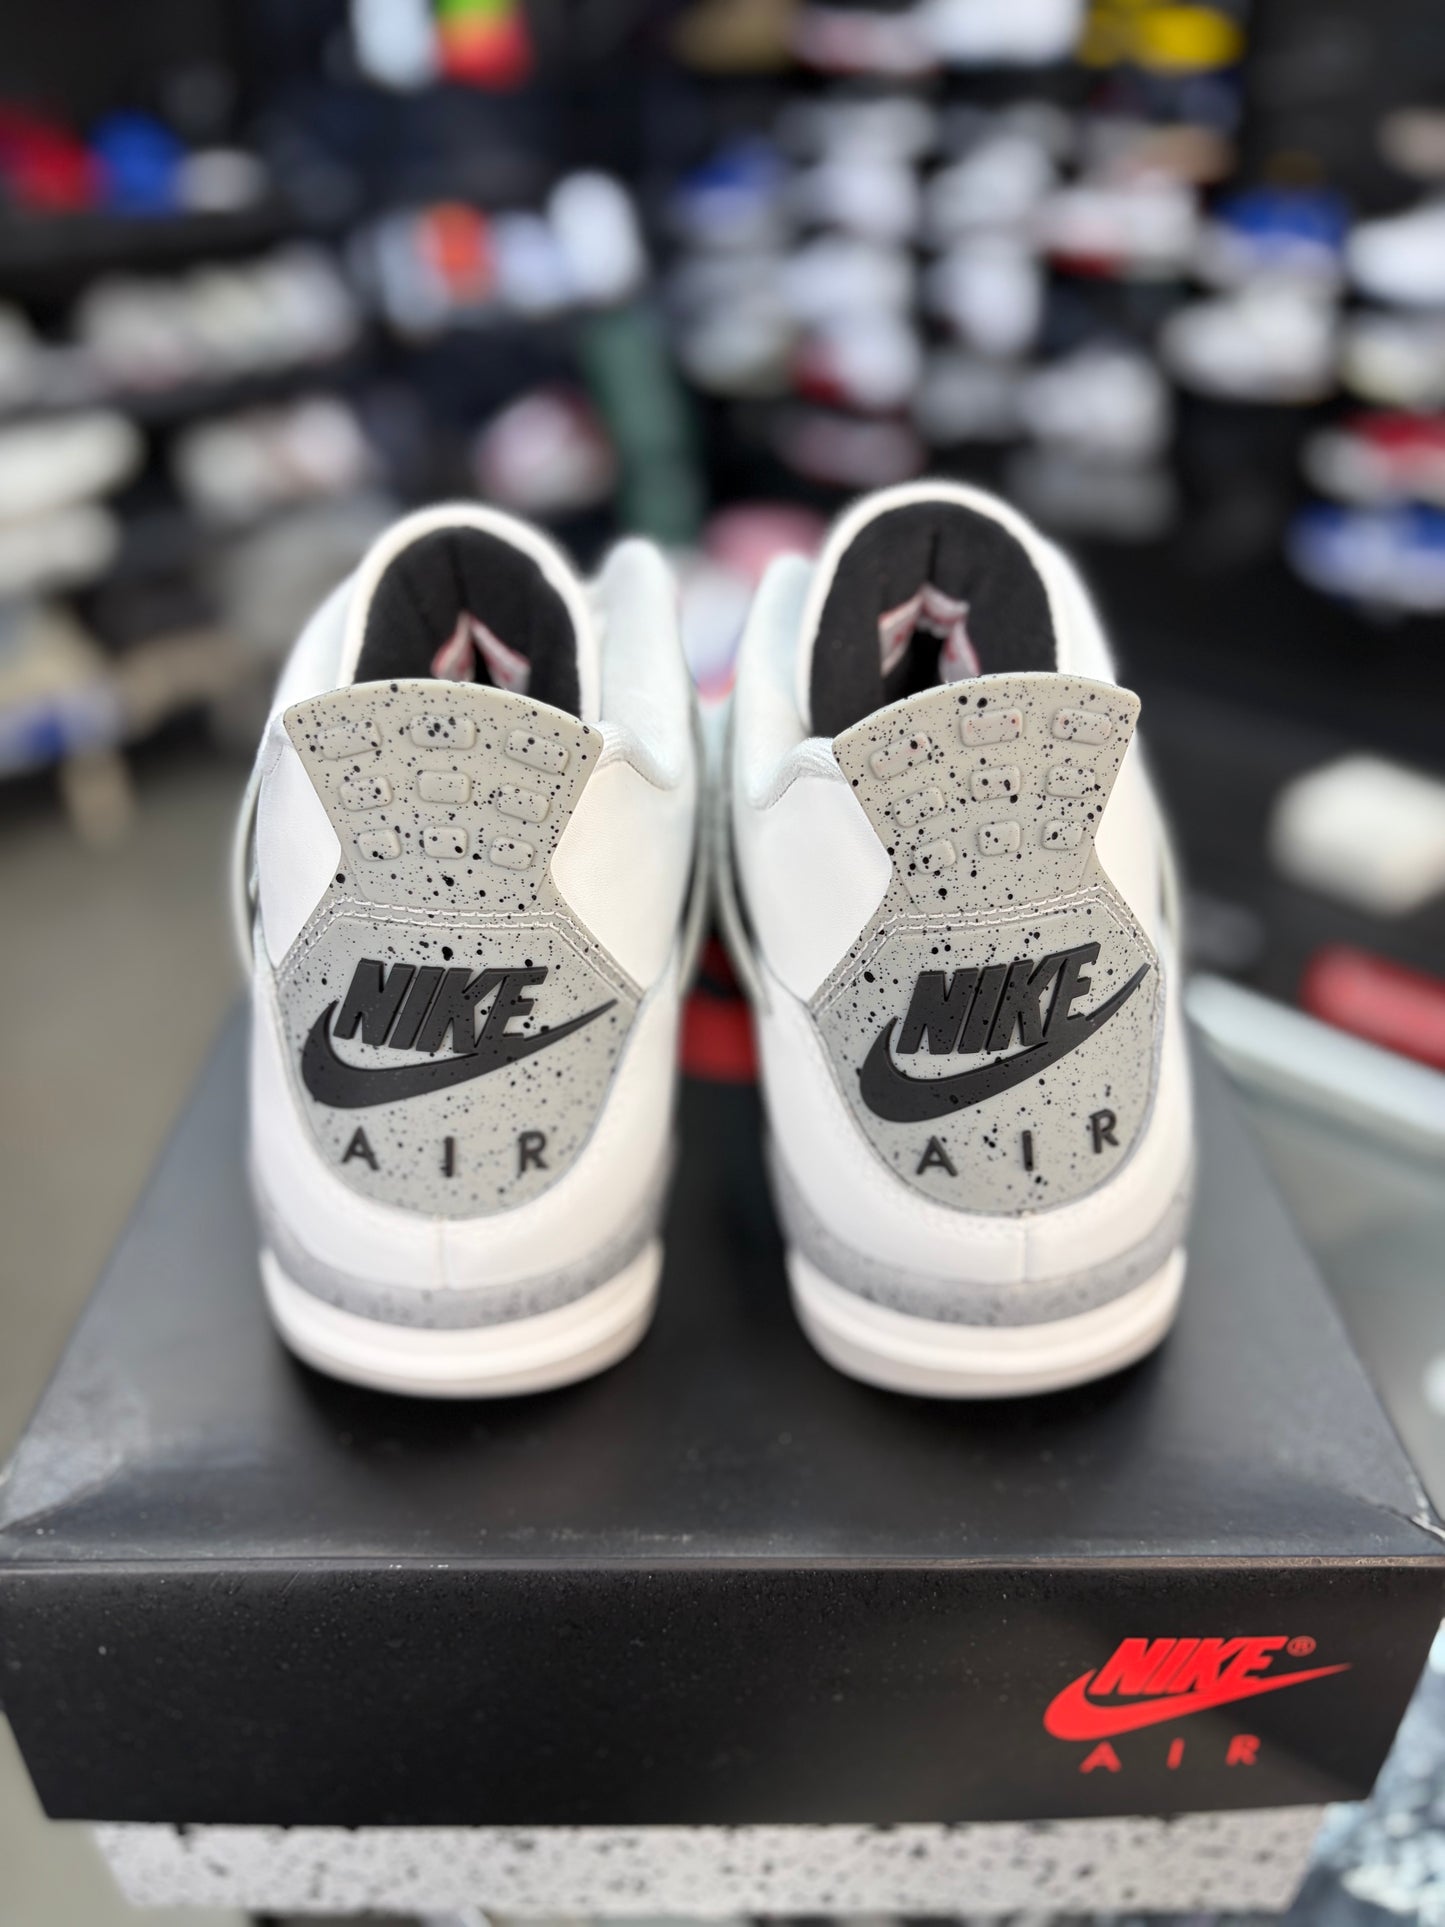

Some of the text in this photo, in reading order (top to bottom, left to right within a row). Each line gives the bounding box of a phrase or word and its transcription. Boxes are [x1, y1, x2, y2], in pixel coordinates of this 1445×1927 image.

[333, 958, 548, 1053] NIKE
[896, 942, 1101, 1055] NIKE
[341, 1127, 547, 1178] AIR
[916, 1109, 1119, 1177] AIR
[1079, 1734, 1261, 1773] AIR
